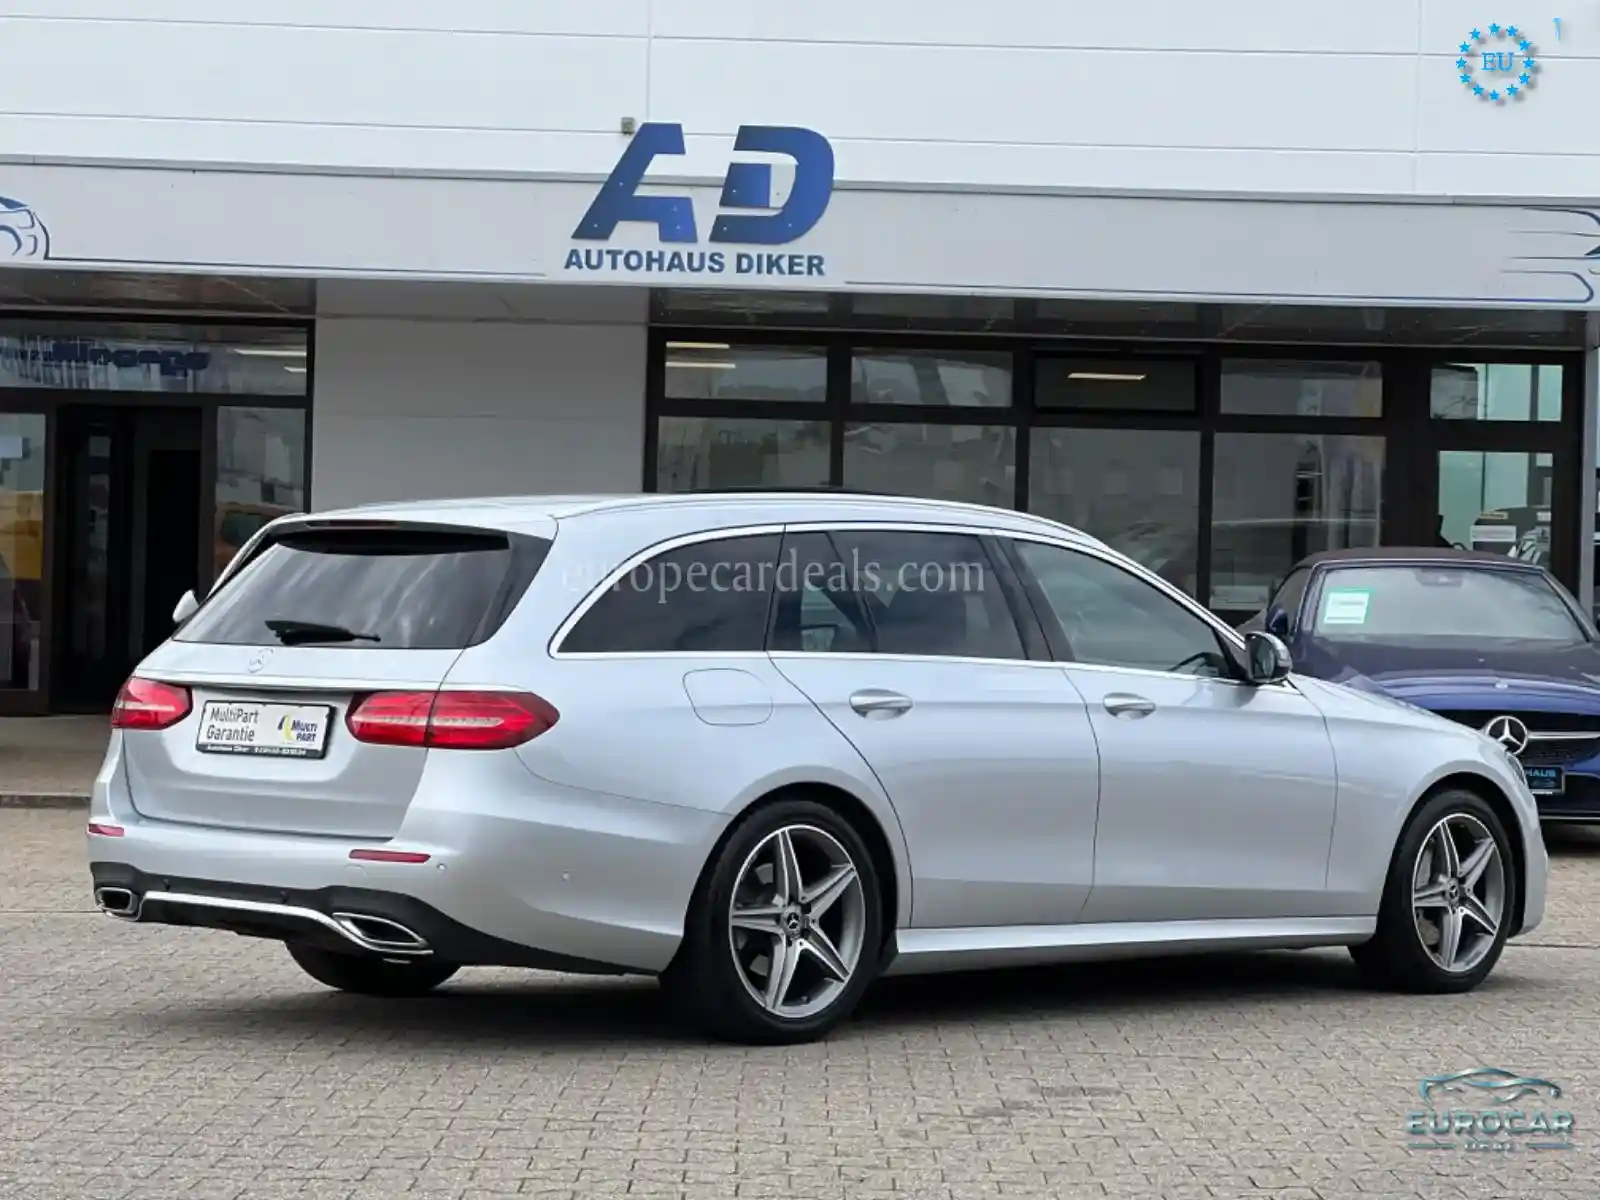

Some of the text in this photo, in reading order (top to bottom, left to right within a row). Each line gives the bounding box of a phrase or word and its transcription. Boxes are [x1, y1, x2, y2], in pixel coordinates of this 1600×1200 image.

[571, 122, 835, 245] AD
[564, 249, 825, 276] AUTOHAUS DIKER
[210, 706, 259, 724] MultiPart
[206, 724, 255, 742] Garantie
[290, 719, 318, 732] MULTI
[295, 732, 317, 743] PART
